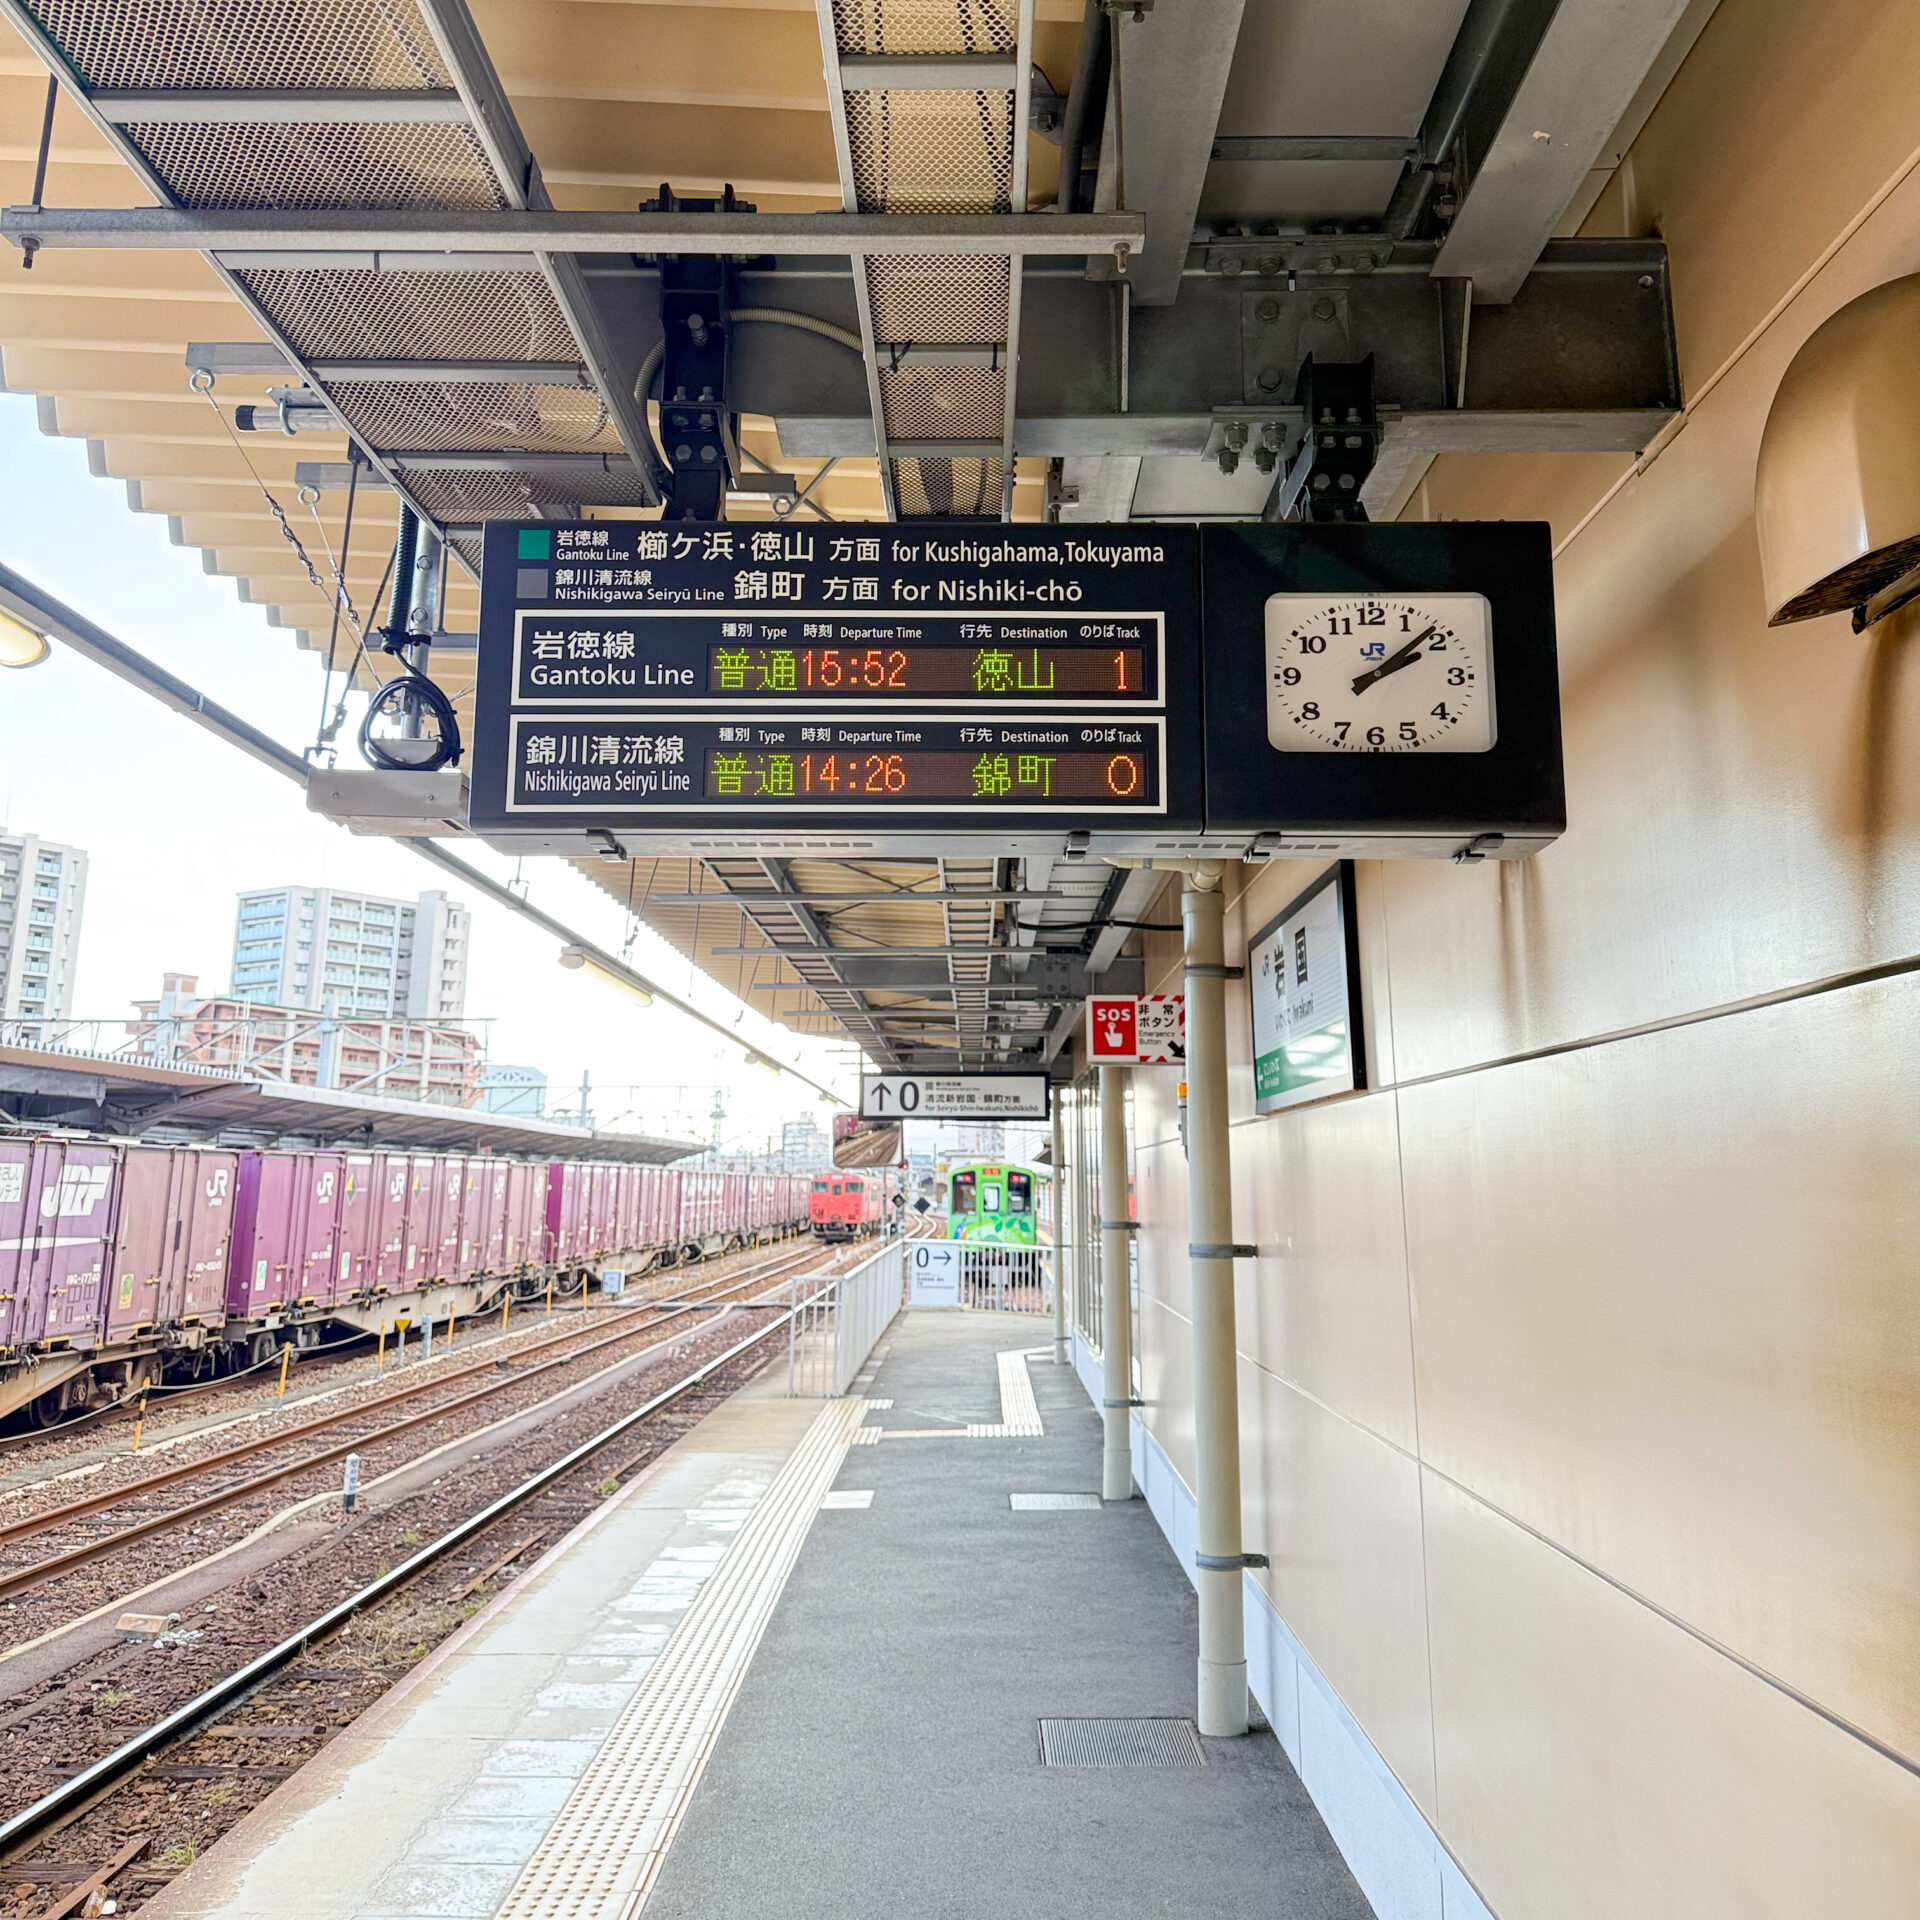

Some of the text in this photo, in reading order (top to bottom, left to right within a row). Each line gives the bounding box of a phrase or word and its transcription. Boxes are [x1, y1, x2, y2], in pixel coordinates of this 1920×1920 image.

[556, 530, 608, 547] 岩徳線
[556, 548, 630, 561] Gantoku Line
[829, 537, 881, 562] 方面
[892, 540, 1164, 567] for Kushigahama,Tokuyama
[555, 568, 652, 586] 錦川清流線
[734, 570, 879, 601] 錦町 方面
[555, 588, 725, 603] Nishikigawa Seiryū Line
[892, 578, 1083, 601] for Nishiki-chō
[1328, 617, 1353, 635] 11
[1356, 608, 1386, 626] 12
[1399, 615, 1411, 632] 1
[722, 623, 752, 638] 種別
[760, 625, 788, 638] Type
[803, 624, 833, 638] 時刻
[840, 626, 922, 641] Departure Time
[960, 624, 993, 639] 行先
[1000, 626, 1068, 639] Destination
[1079, 624, 1115, 638] のりば
[1116, 626, 1140, 639] Track
[531, 630, 636, 660] 岩徳線
[1299, 636, 1327, 654] 10
[1360, 643, 1385, 656] JR
[1428, 633, 1447, 651] 2
[530, 664, 695, 686] Gantoku Line
[714, 647, 798, 690] 普通
[802, 650, 907, 687] 15:52
[972, 648, 1054, 691] 徳山
[1114, 651, 1127, 690] 1
[1283, 667, 1301, 685] 9
[1447, 667, 1465, 685] 3
[1301, 702, 1320, 720] 8
[1430, 702, 1450, 720] 4
[718, 727, 750, 742] 種別
[758, 730, 786, 743] Type
[801, 728, 831, 742] 時刻
[838, 730, 922, 744] Departure Time
[960, 728, 993, 742] 行先
[1001, 731, 1069, 743] Destination
[1080, 728, 1116, 742] のりば
[1118, 731, 1142, 743] Track
[1334, 722, 1352, 740] 7
[1366, 727, 1385, 745] 6
[1399, 721, 1418, 740] 5
[526, 735, 685, 766] 錦川清流線
[711, 752, 796, 796] 普通
[800, 755, 906, 791] 14:26
[972, 753, 1057, 796] 錦町
[1107, 756, 1137, 795] 0
[524, 770, 691, 796] Nishikigawa Seiryū Line
[1096, 1008, 1131, 1022] SOS
[1139, 1017, 1175, 1028] ボタン
[1138, 1030, 1175, 1038] Emergency
[900, 1081, 919, 1112] 0
[206, 1169, 229, 1197] JR
[317, 1172, 335, 1197] JR
[390, 1172, 406, 1196] JR
[448, 1174, 461, 1196] JR
[916, 1247, 929, 1268] 0
